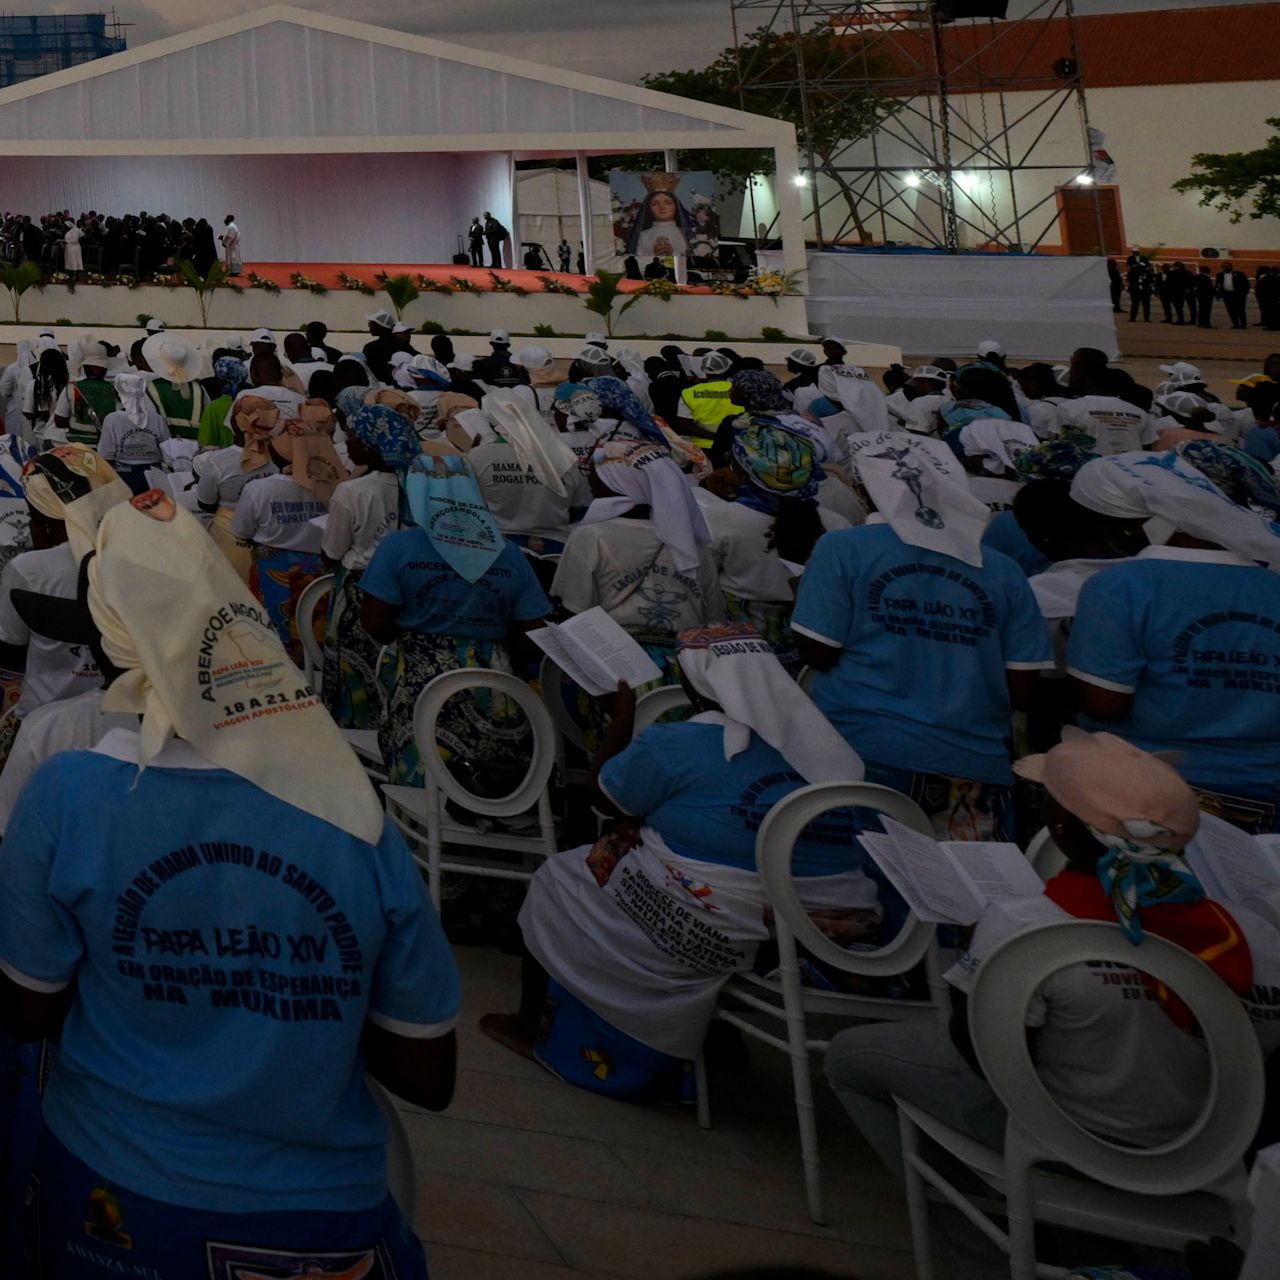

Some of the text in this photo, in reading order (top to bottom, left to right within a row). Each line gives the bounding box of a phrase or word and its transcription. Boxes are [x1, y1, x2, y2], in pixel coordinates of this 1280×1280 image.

[493, 474, 524, 485] ROGAI
[653, 565, 669, 577] DE
[228, 601, 278, 632] NGOLA
[197, 606, 233, 703] ABENÇOE
[711, 640, 761, 659] LEGIÃO DE
[212, 713, 251, 731] VIAGEM
[223, 701, 246, 717] 18
[249, 697, 263, 710] A
[264, 692, 290, 706] 21
[112, 840, 364, 975] A LEGIÃO DE MARIA UNIDO AO SANTO PADRE
[620, 877, 667, 928] SENHORA
[667, 924, 686, 943] DE
[636, 869, 730, 946] DIOCESE DE VIANA
[141, 924, 329, 965] PAPA LEÃO XIV
[688, 928, 746, 961] NOSSA
[116, 958, 363, 1003] EM ORAÇÃO DE ESPERANÇA
[142, 982, 344, 1022] NA MUXIMA
